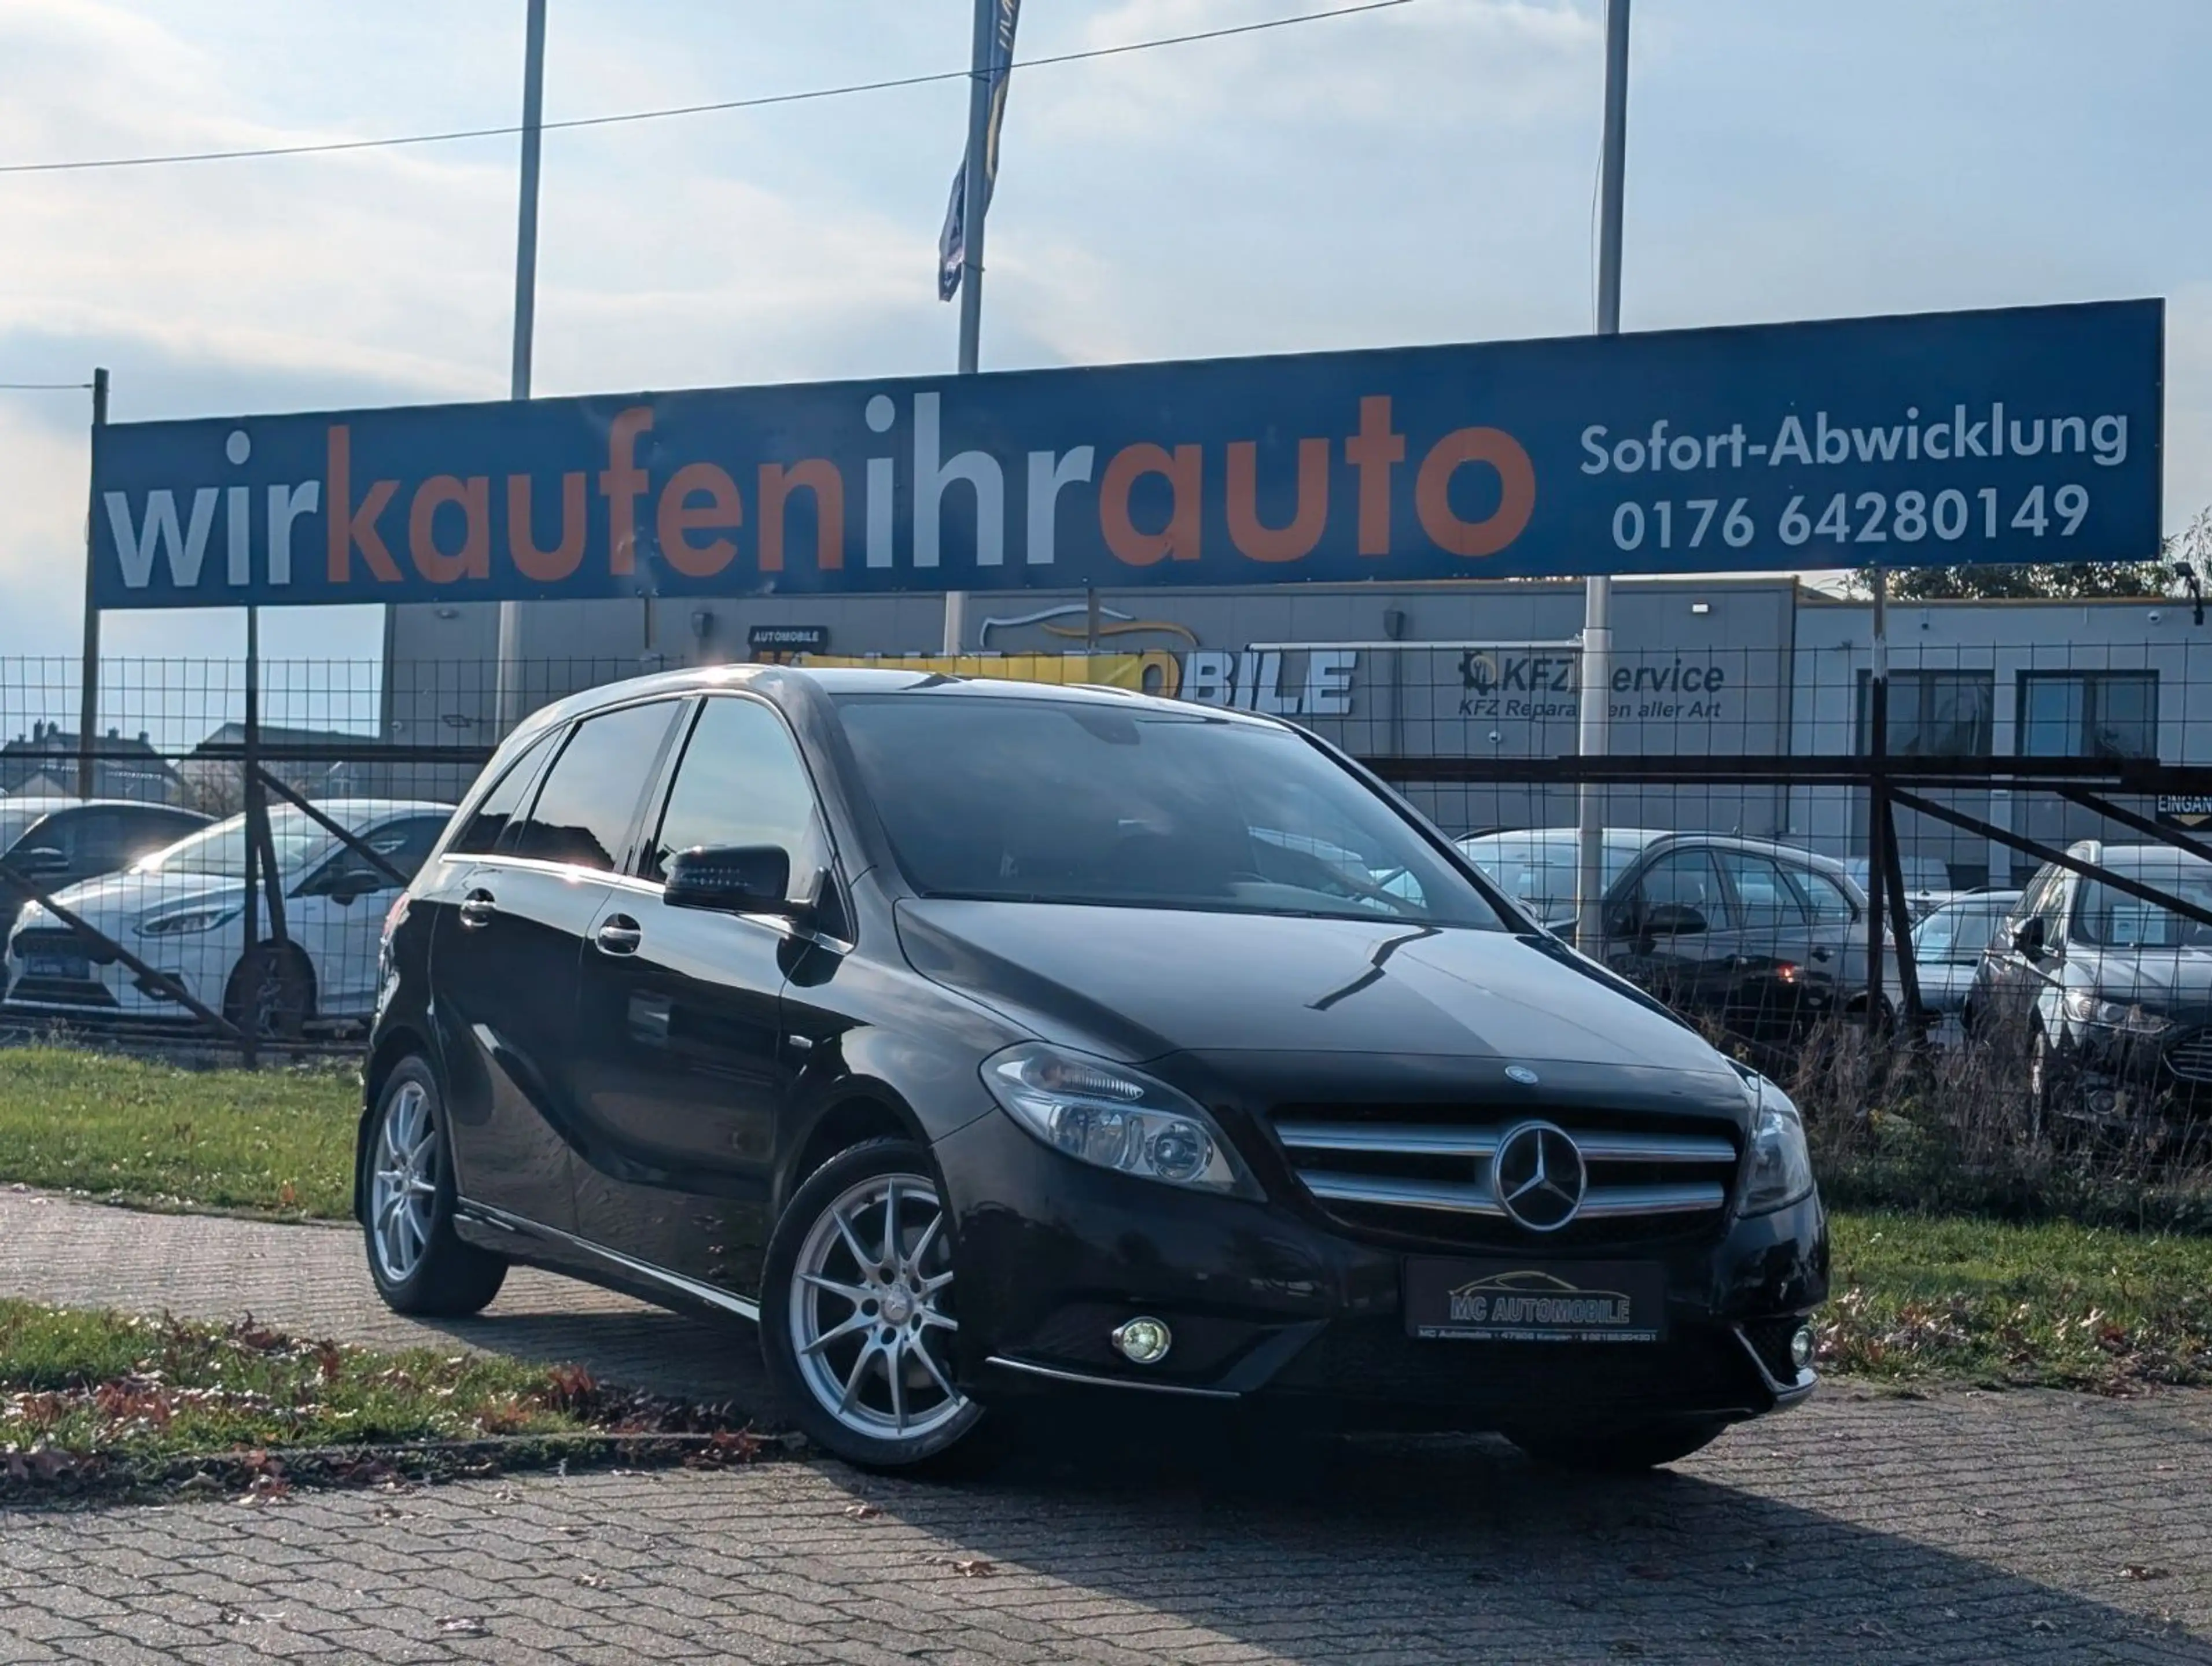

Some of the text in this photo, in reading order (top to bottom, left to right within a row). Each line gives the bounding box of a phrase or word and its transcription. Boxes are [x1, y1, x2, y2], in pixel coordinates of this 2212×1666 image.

[1580, 402, 2128, 474] Sofort-Abwicklung
[1612, 484, 2090, 550] 0176 64280149
[753, 631, 819, 642] AUTOMOBILE
[1612, 658, 1724, 692] ervice
[1458, 699, 1721, 722] KFZ Reparaen aller Art
[1450, 1296, 1631, 1324] MC AUTOMOBILE
